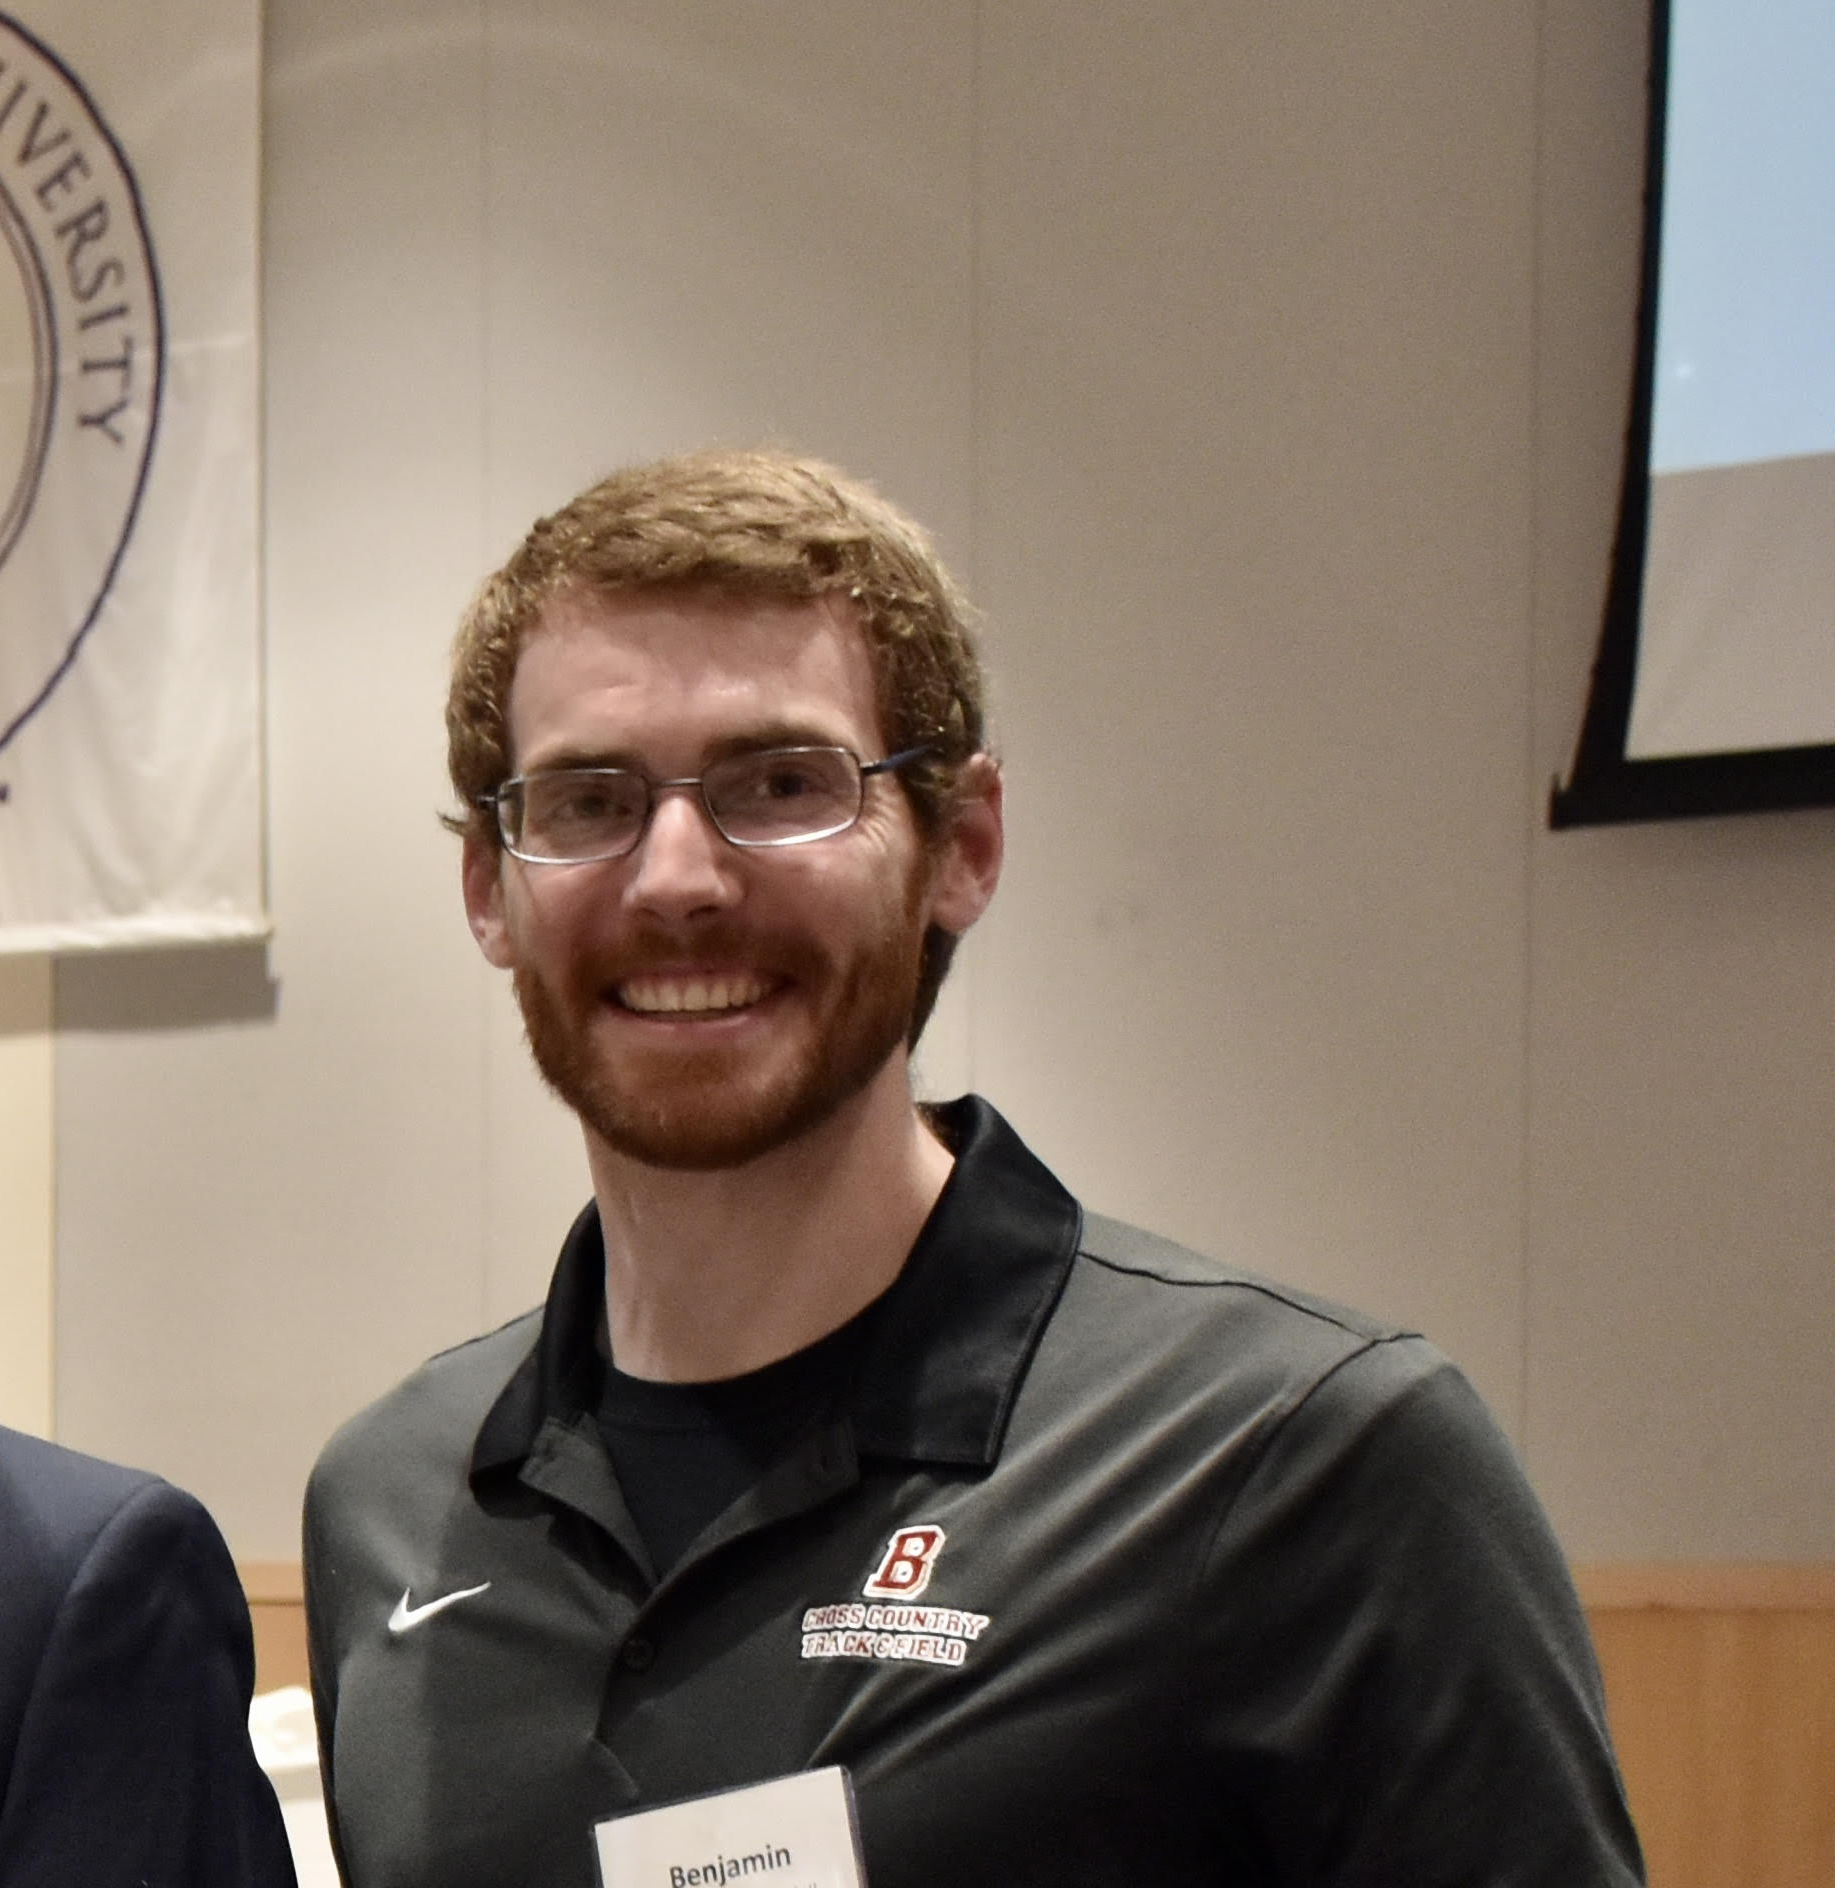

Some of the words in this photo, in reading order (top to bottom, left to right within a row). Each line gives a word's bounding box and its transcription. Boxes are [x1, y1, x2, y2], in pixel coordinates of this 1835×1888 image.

[863, 1525, 946, 1600] B
[802, 1604, 866, 1632] CROSS
[866, 1605, 991, 1640] COUNTRY
[801, 1631, 875, 1659] TRACK
[893, 1634, 967, 1667] FIELD
